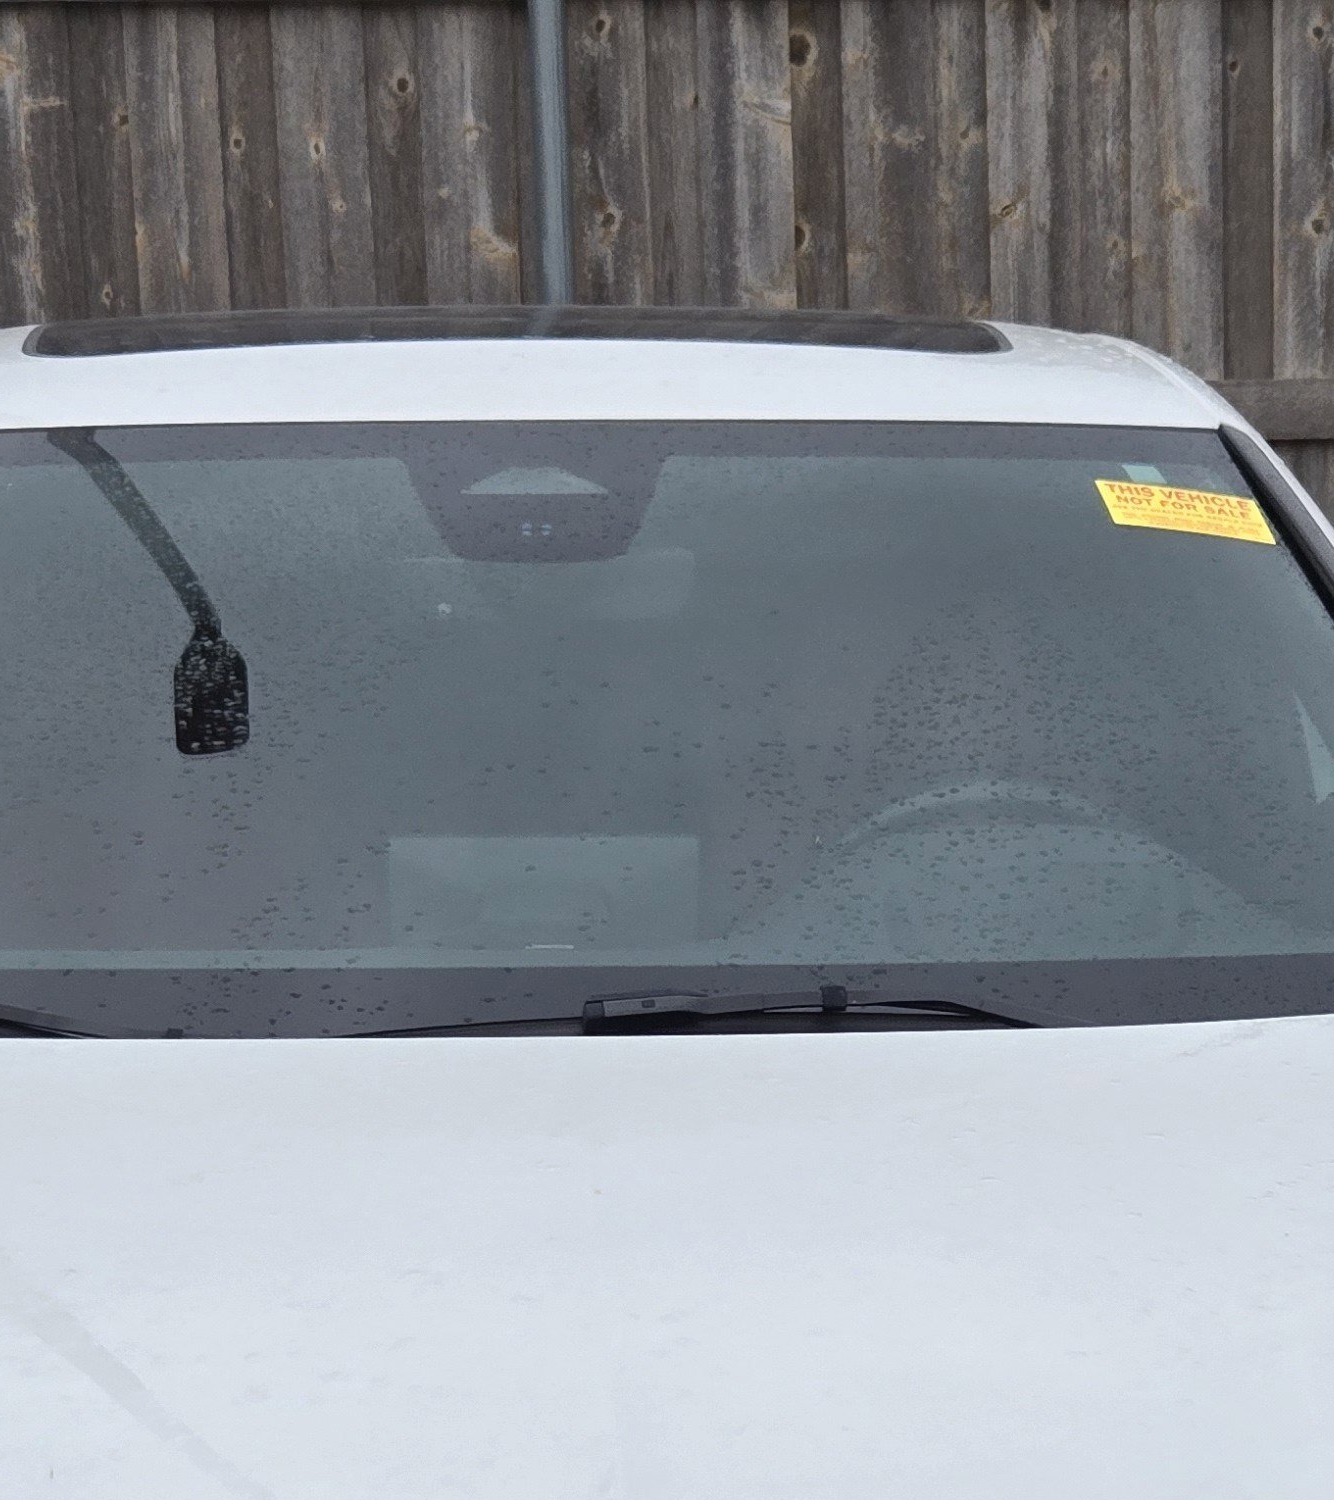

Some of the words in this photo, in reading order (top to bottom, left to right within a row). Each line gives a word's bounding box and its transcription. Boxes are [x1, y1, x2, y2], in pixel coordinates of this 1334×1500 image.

[1104, 483, 1155, 498] THIS
[1159, 488, 1252, 512] VEHICLE
[1115, 494, 1153, 507] NOT
[1159, 499, 1198, 513] FOR
[1203, 505, 1252, 520] SALE
